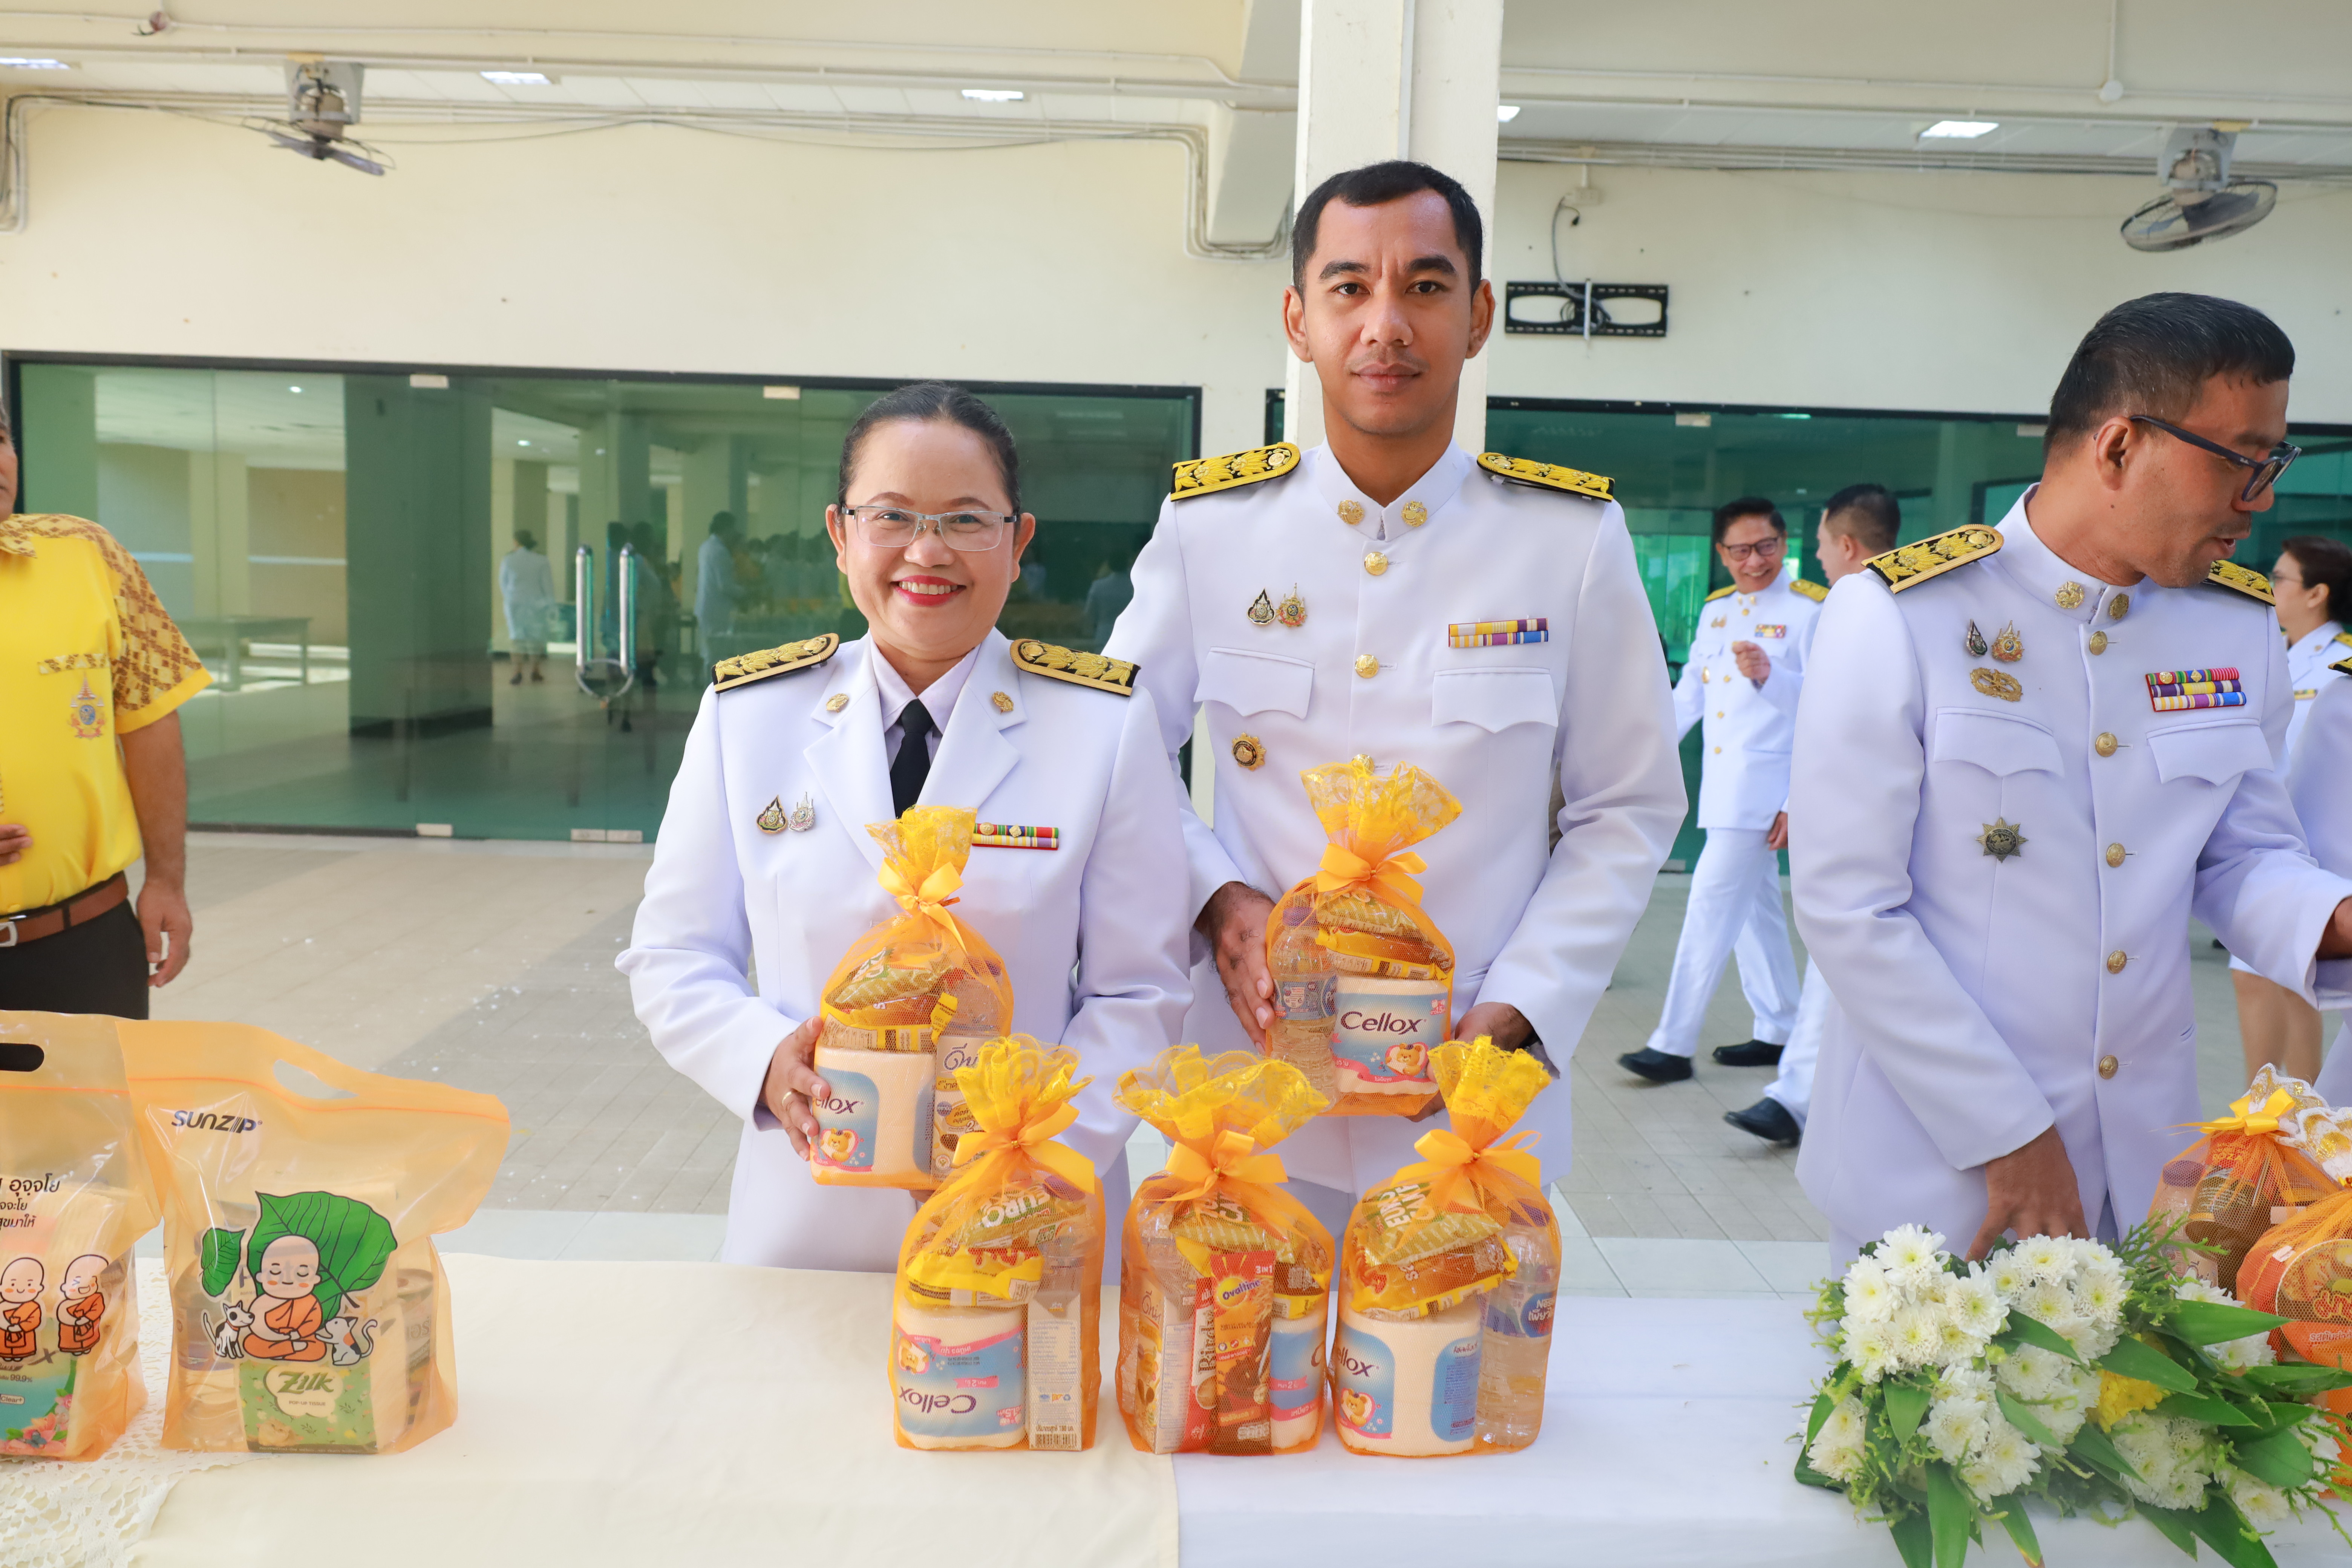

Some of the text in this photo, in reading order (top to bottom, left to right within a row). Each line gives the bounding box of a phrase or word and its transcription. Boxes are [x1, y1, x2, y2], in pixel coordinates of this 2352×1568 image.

[1340, 1011, 1423, 1035] Cellox
[1222, 1279, 1261, 1300] Ovaltine
[277, 1371, 334, 1395] Zilk
[899, 1386, 977, 1414] Cellox
